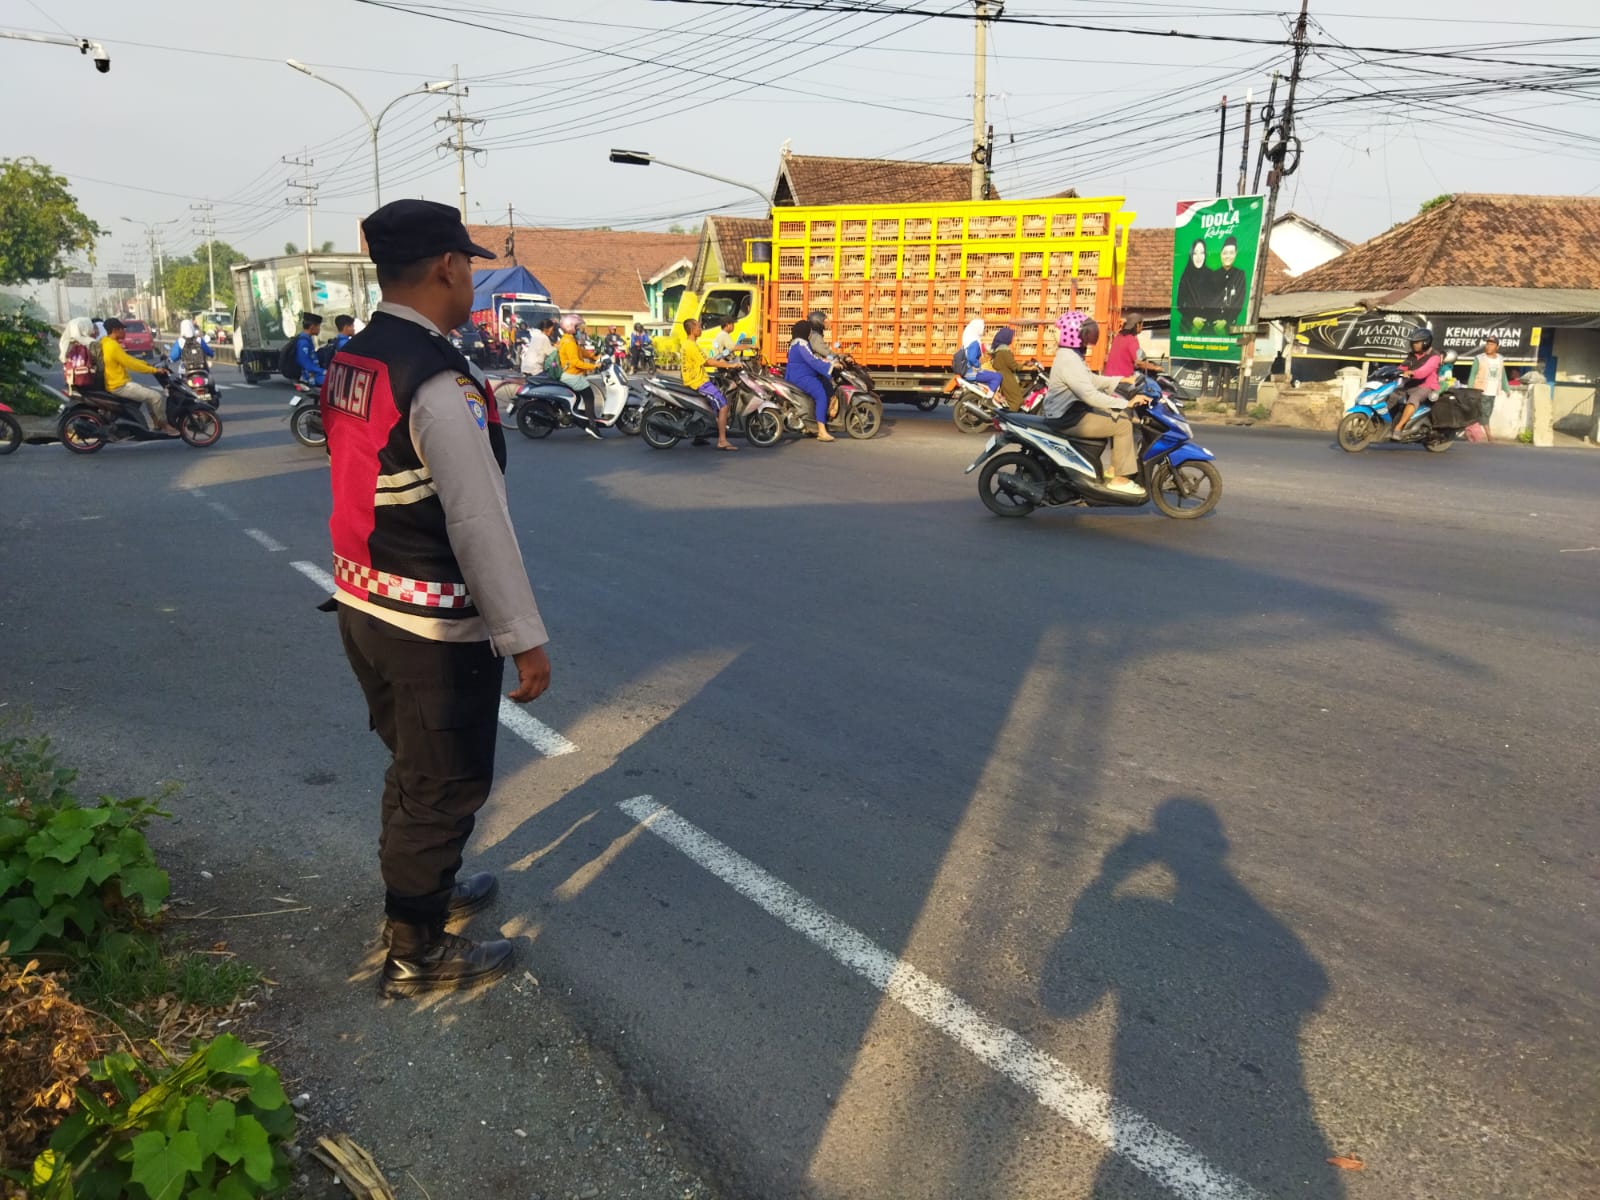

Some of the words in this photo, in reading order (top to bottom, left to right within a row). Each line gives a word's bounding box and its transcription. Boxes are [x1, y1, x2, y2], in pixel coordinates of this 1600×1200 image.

[1201, 209, 1240, 228] IDOLA
[1356, 324, 1412, 338] MAGNU
[1445, 326, 1522, 338] KENIKMATAN
[1364, 335, 1406, 348] KRETEK
[1443, 338, 1477, 347] KRETEK
[1479, 338, 1520, 347] MDERN
[327, 360, 371, 417] POLISI
